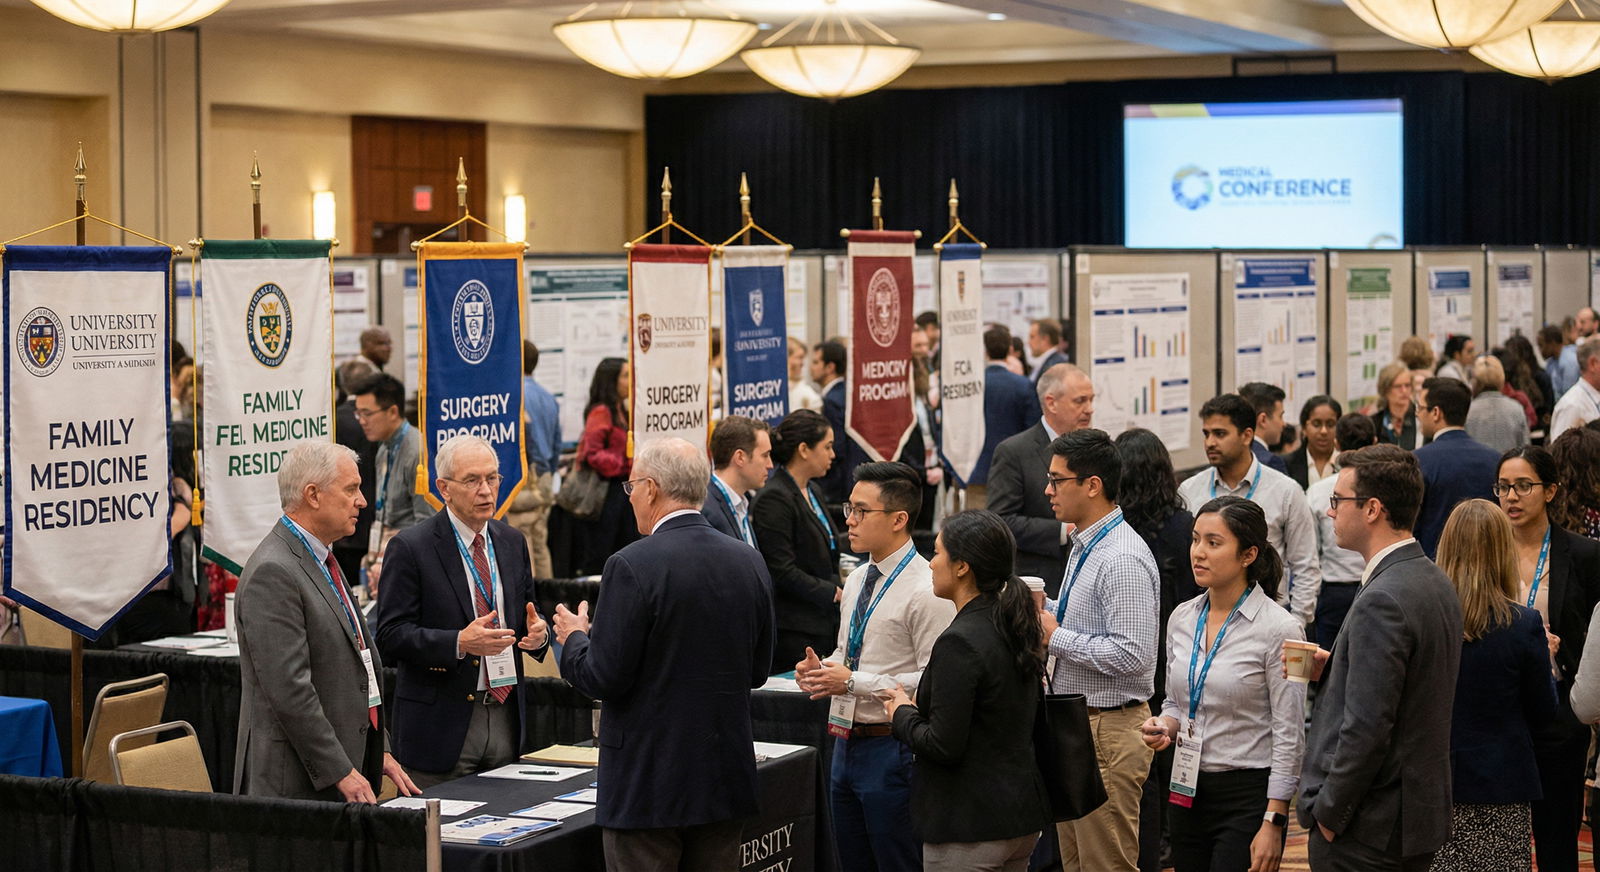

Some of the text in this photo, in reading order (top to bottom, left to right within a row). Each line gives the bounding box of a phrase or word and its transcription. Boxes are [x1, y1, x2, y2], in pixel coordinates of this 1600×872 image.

[1219, 178, 1352, 197] CONFERENCE
[70, 313, 157, 331] UNIVERSITY
[654, 315, 707, 332] UNIVERSITY
[70, 333, 157, 351] UNIVERSITY
[72, 360, 116, 370] UNIVERSITY
[243, 389, 303, 414] FAMILY
[646, 384, 701, 406] SURGERY
[734, 379, 782, 402] SURGERY
[440, 392, 510, 421] SURGERY
[253, 415, 328, 444] MEDICINE
[645, 409, 703, 432] PROGRAM
[49, 418, 134, 450] FAMILY
[30, 454, 148, 491] MEDICINE
[24, 491, 159, 532] RESIDENCY
[739, 822, 794, 868] ERSITY
